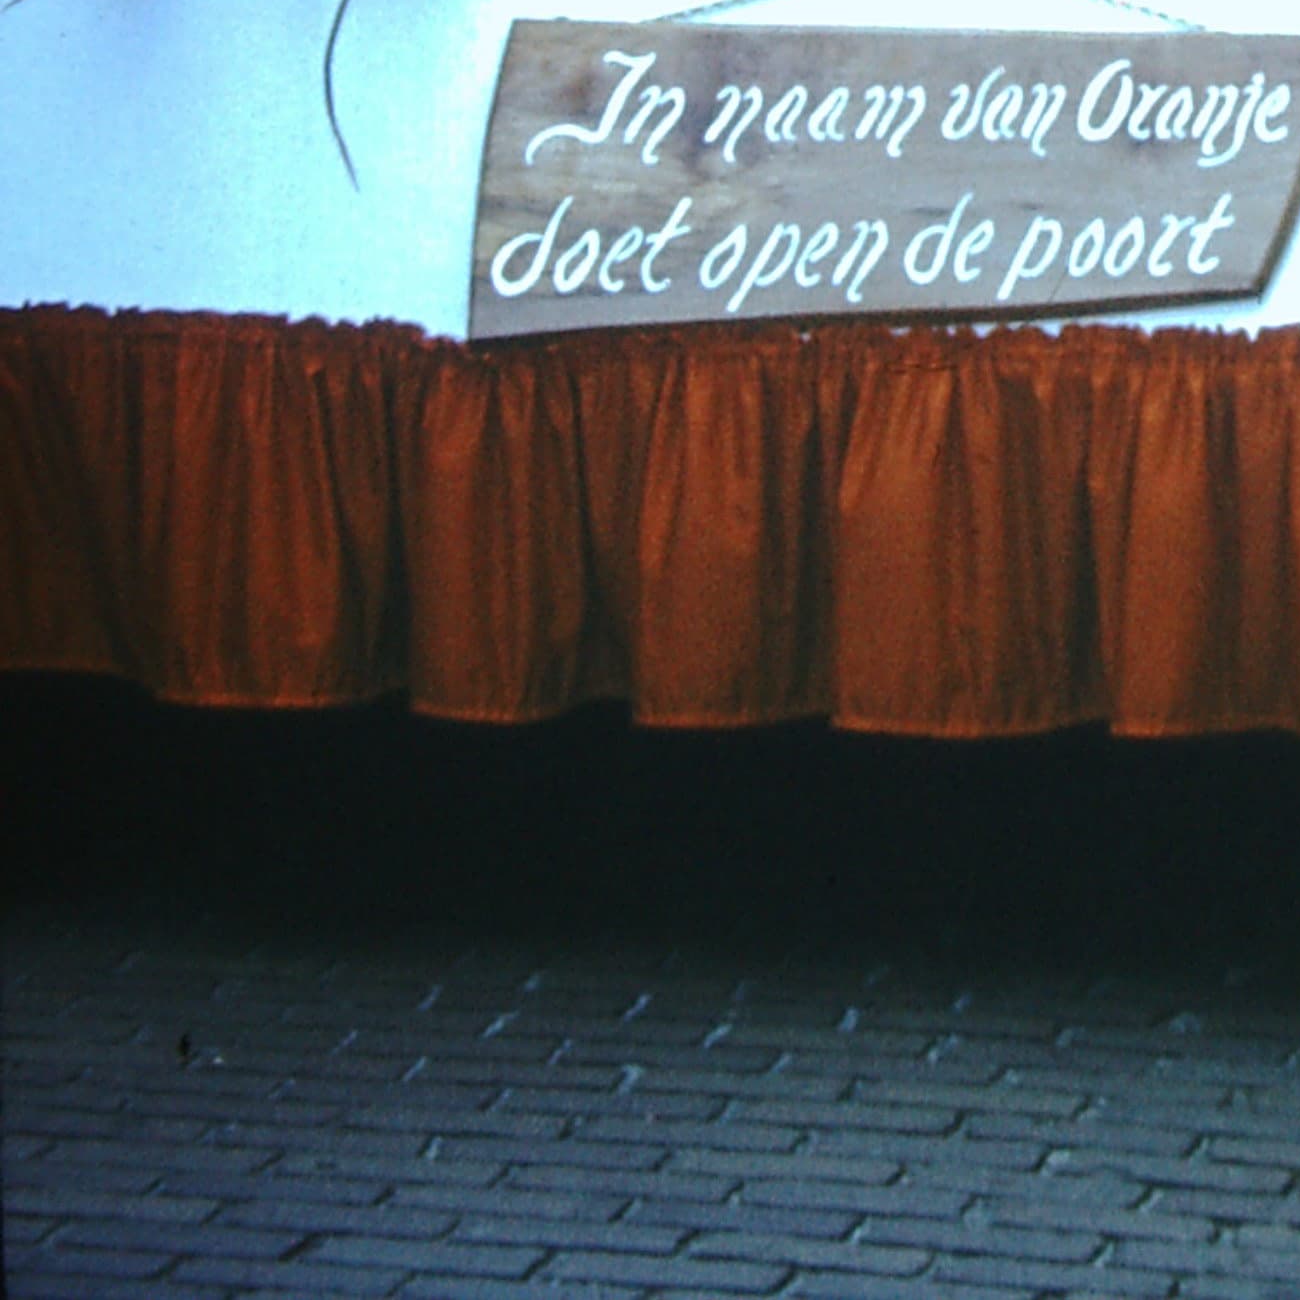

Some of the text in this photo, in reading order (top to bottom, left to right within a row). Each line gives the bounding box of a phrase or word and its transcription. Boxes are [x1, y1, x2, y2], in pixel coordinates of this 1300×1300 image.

[524, 49, 1292, 168] In naam van Oranje
[490, 191, 1236, 314] doet open de poort
